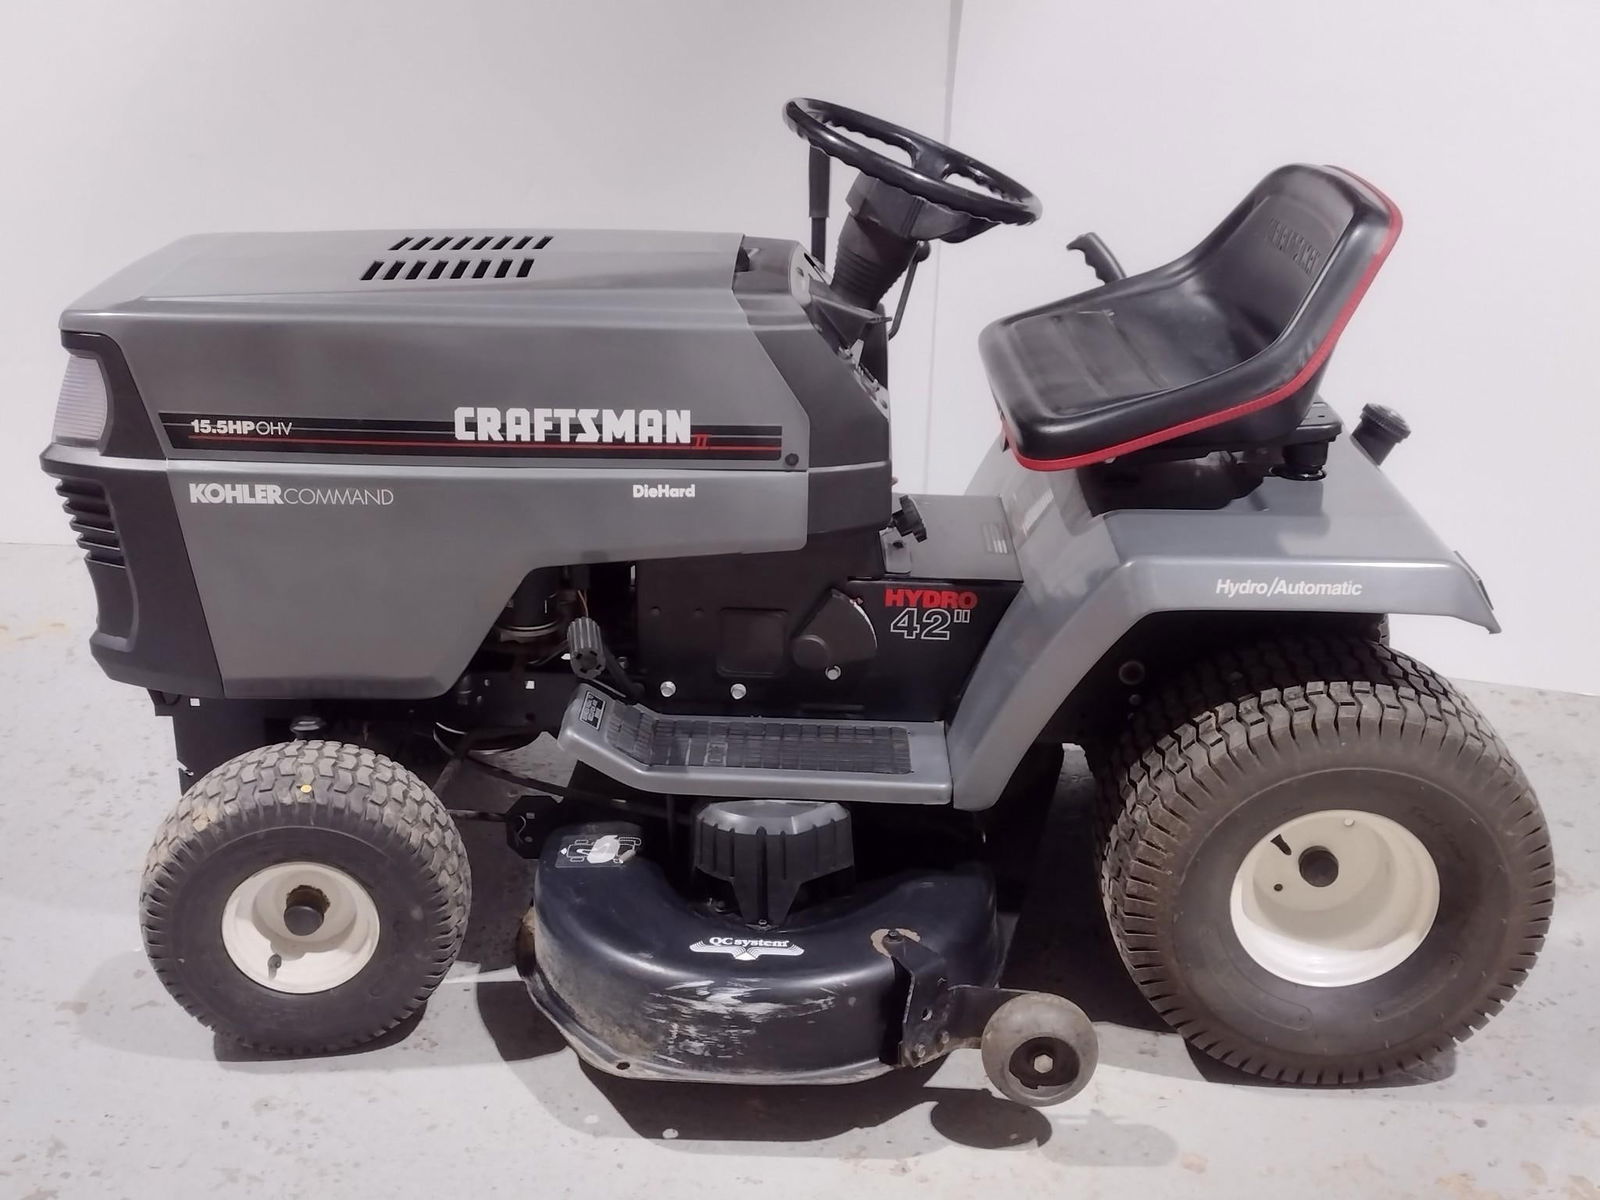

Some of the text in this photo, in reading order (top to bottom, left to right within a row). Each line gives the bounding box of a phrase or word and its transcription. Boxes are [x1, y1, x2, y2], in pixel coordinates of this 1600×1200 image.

[454, 406, 691, 444] CRAFTSMAN
[189, 483, 394, 506] KOHLER COMMAND
[632, 483, 696, 499] DieHard
[1215, 576, 1363, 598] Hydro/Automatic
[885, 589, 978, 608] HYDRO
